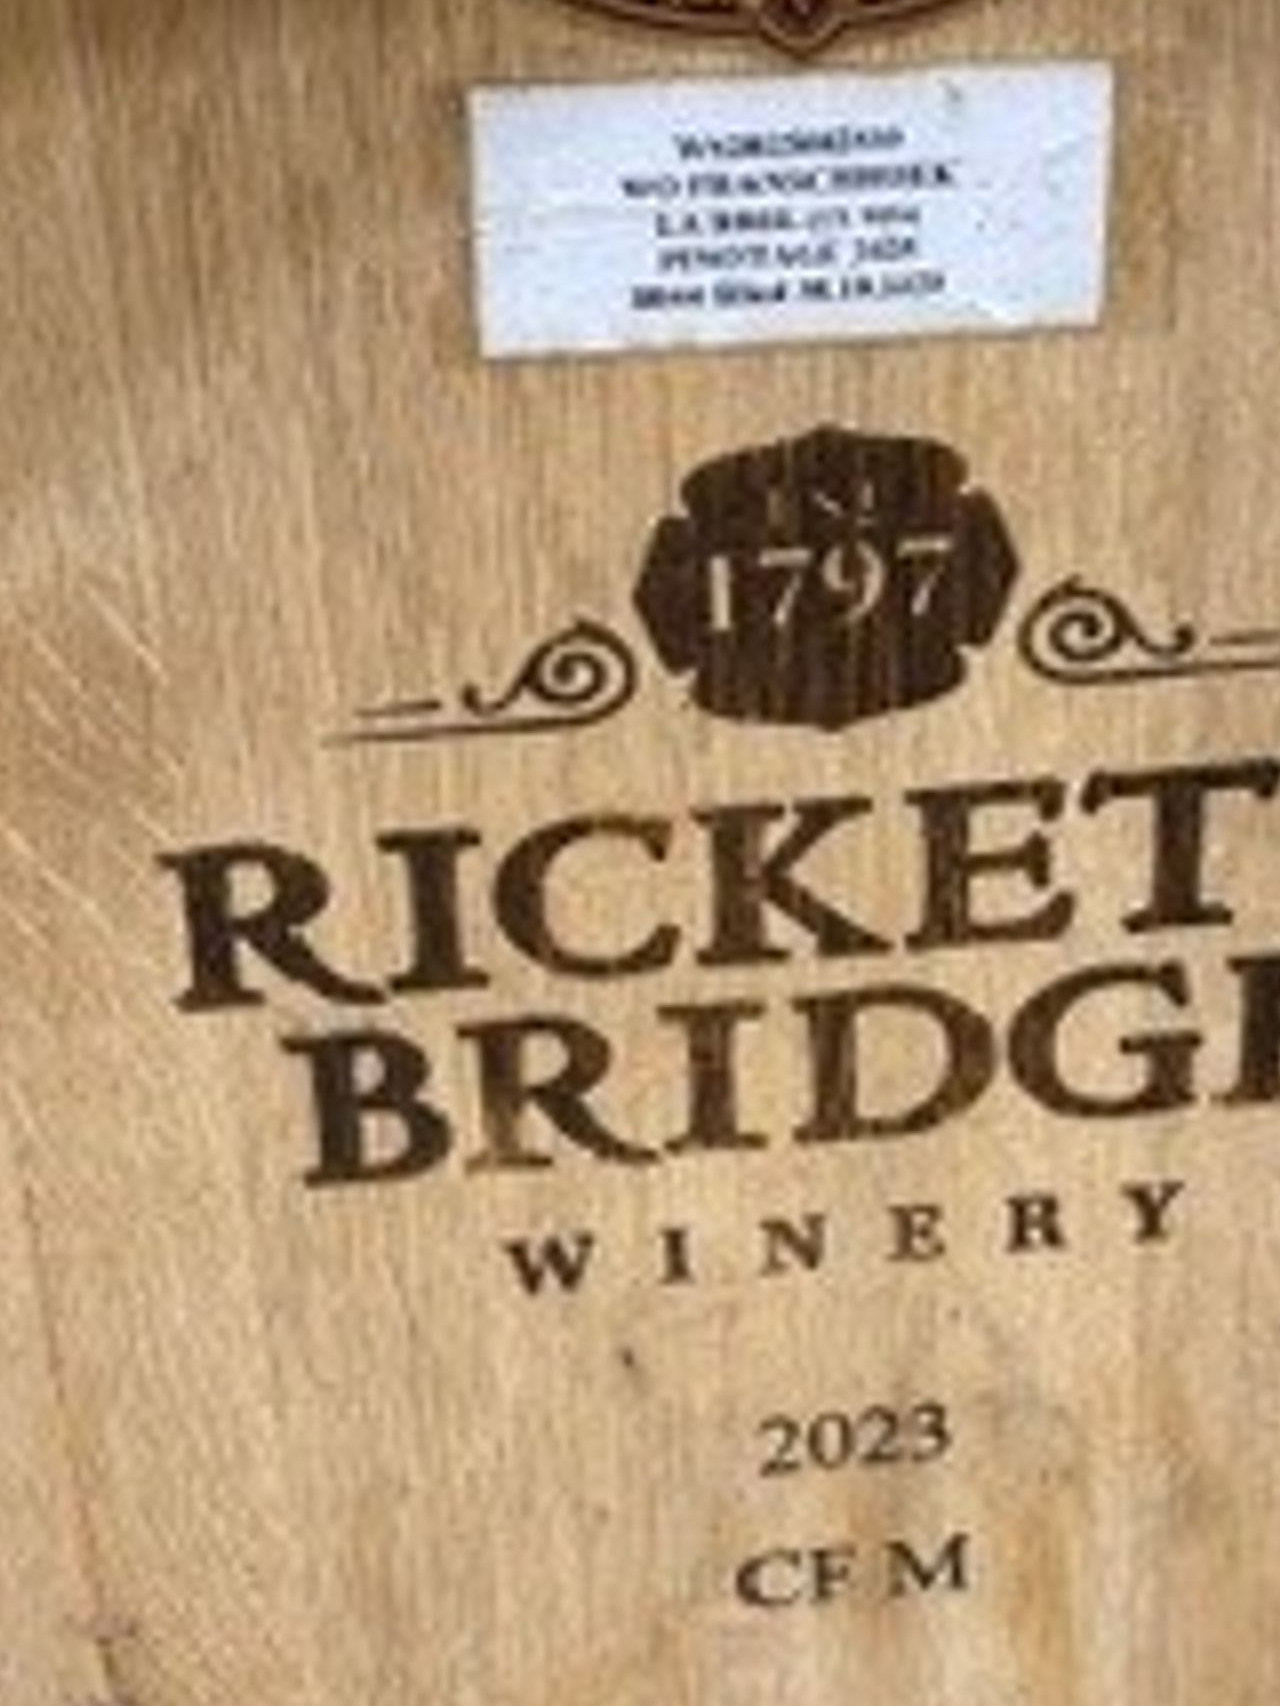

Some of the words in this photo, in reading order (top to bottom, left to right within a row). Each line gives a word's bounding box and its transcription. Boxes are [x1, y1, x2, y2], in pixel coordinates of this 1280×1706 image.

[708, 535, 955, 631] 1797
[503, 1180, 1186, 1296] WINERY
[758, 1403, 953, 1479] 2023
